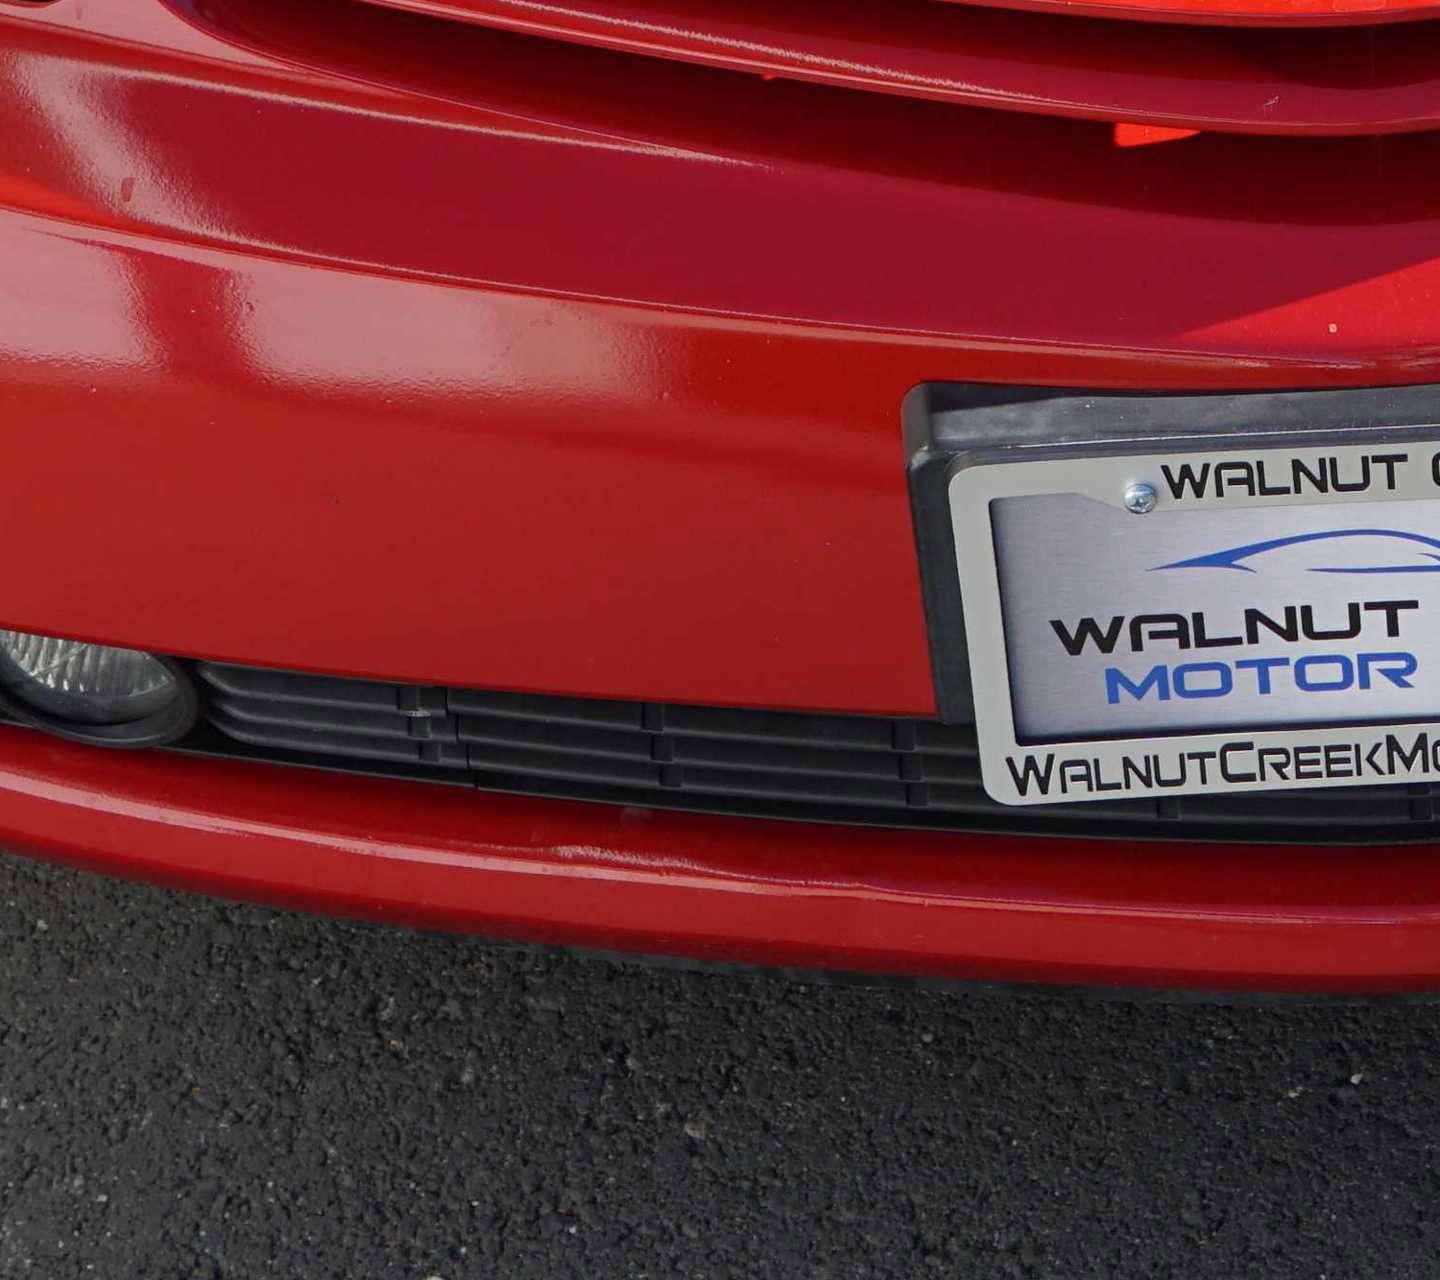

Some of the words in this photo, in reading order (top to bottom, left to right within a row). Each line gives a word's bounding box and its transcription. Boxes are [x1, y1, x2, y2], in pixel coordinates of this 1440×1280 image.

[1160, 453, 1409, 500] WALNUT
[1048, 599, 1419, 657] WALNUT
[1105, 652, 1417, 704] MOTOR
